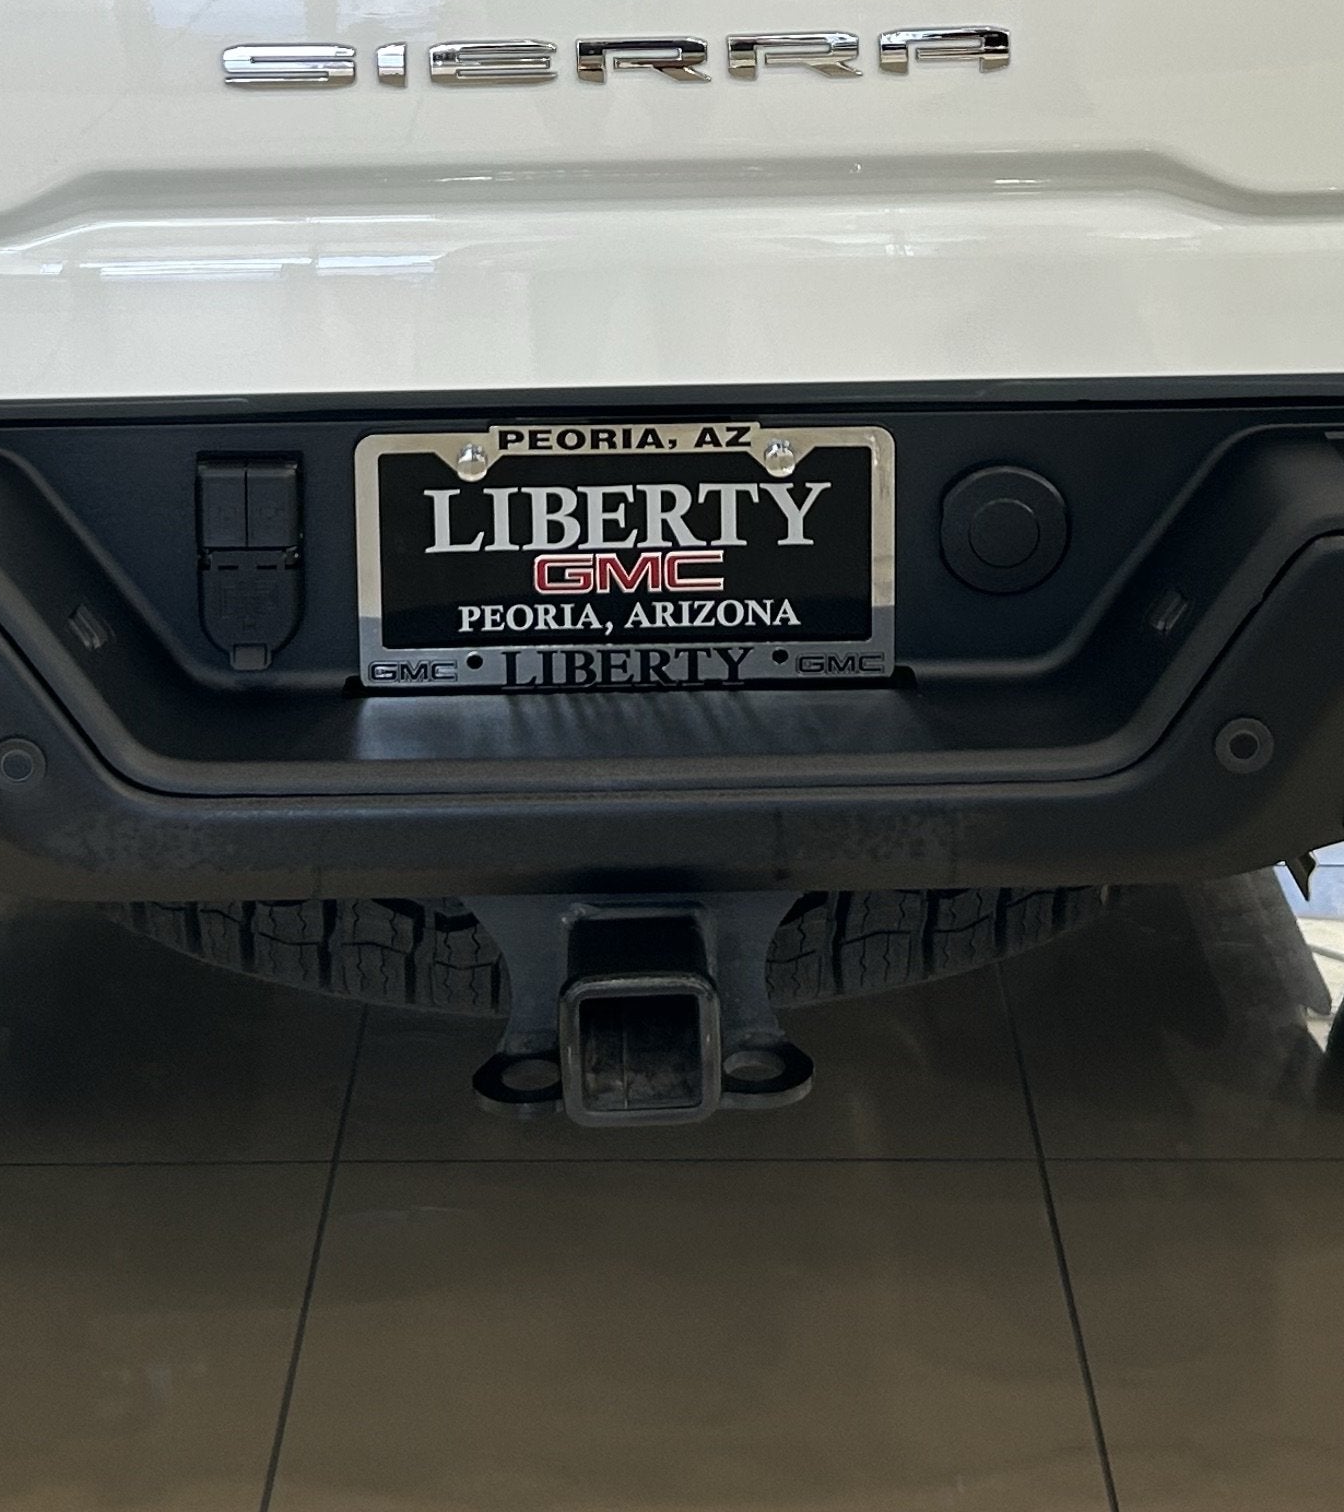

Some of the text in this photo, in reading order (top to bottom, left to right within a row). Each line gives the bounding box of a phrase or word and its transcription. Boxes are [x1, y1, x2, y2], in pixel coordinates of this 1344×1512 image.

[221, 25, 1013, 87] SIERRA
[498, 424, 753, 451] PEORIA, AZ
[424, 481, 832, 554] LIBERTY
[533, 550, 725, 594] GMC
[458, 598, 801, 635] PEORIA, ARIZONA
[369, 647, 885, 688] GMC LIBERTY GMC
